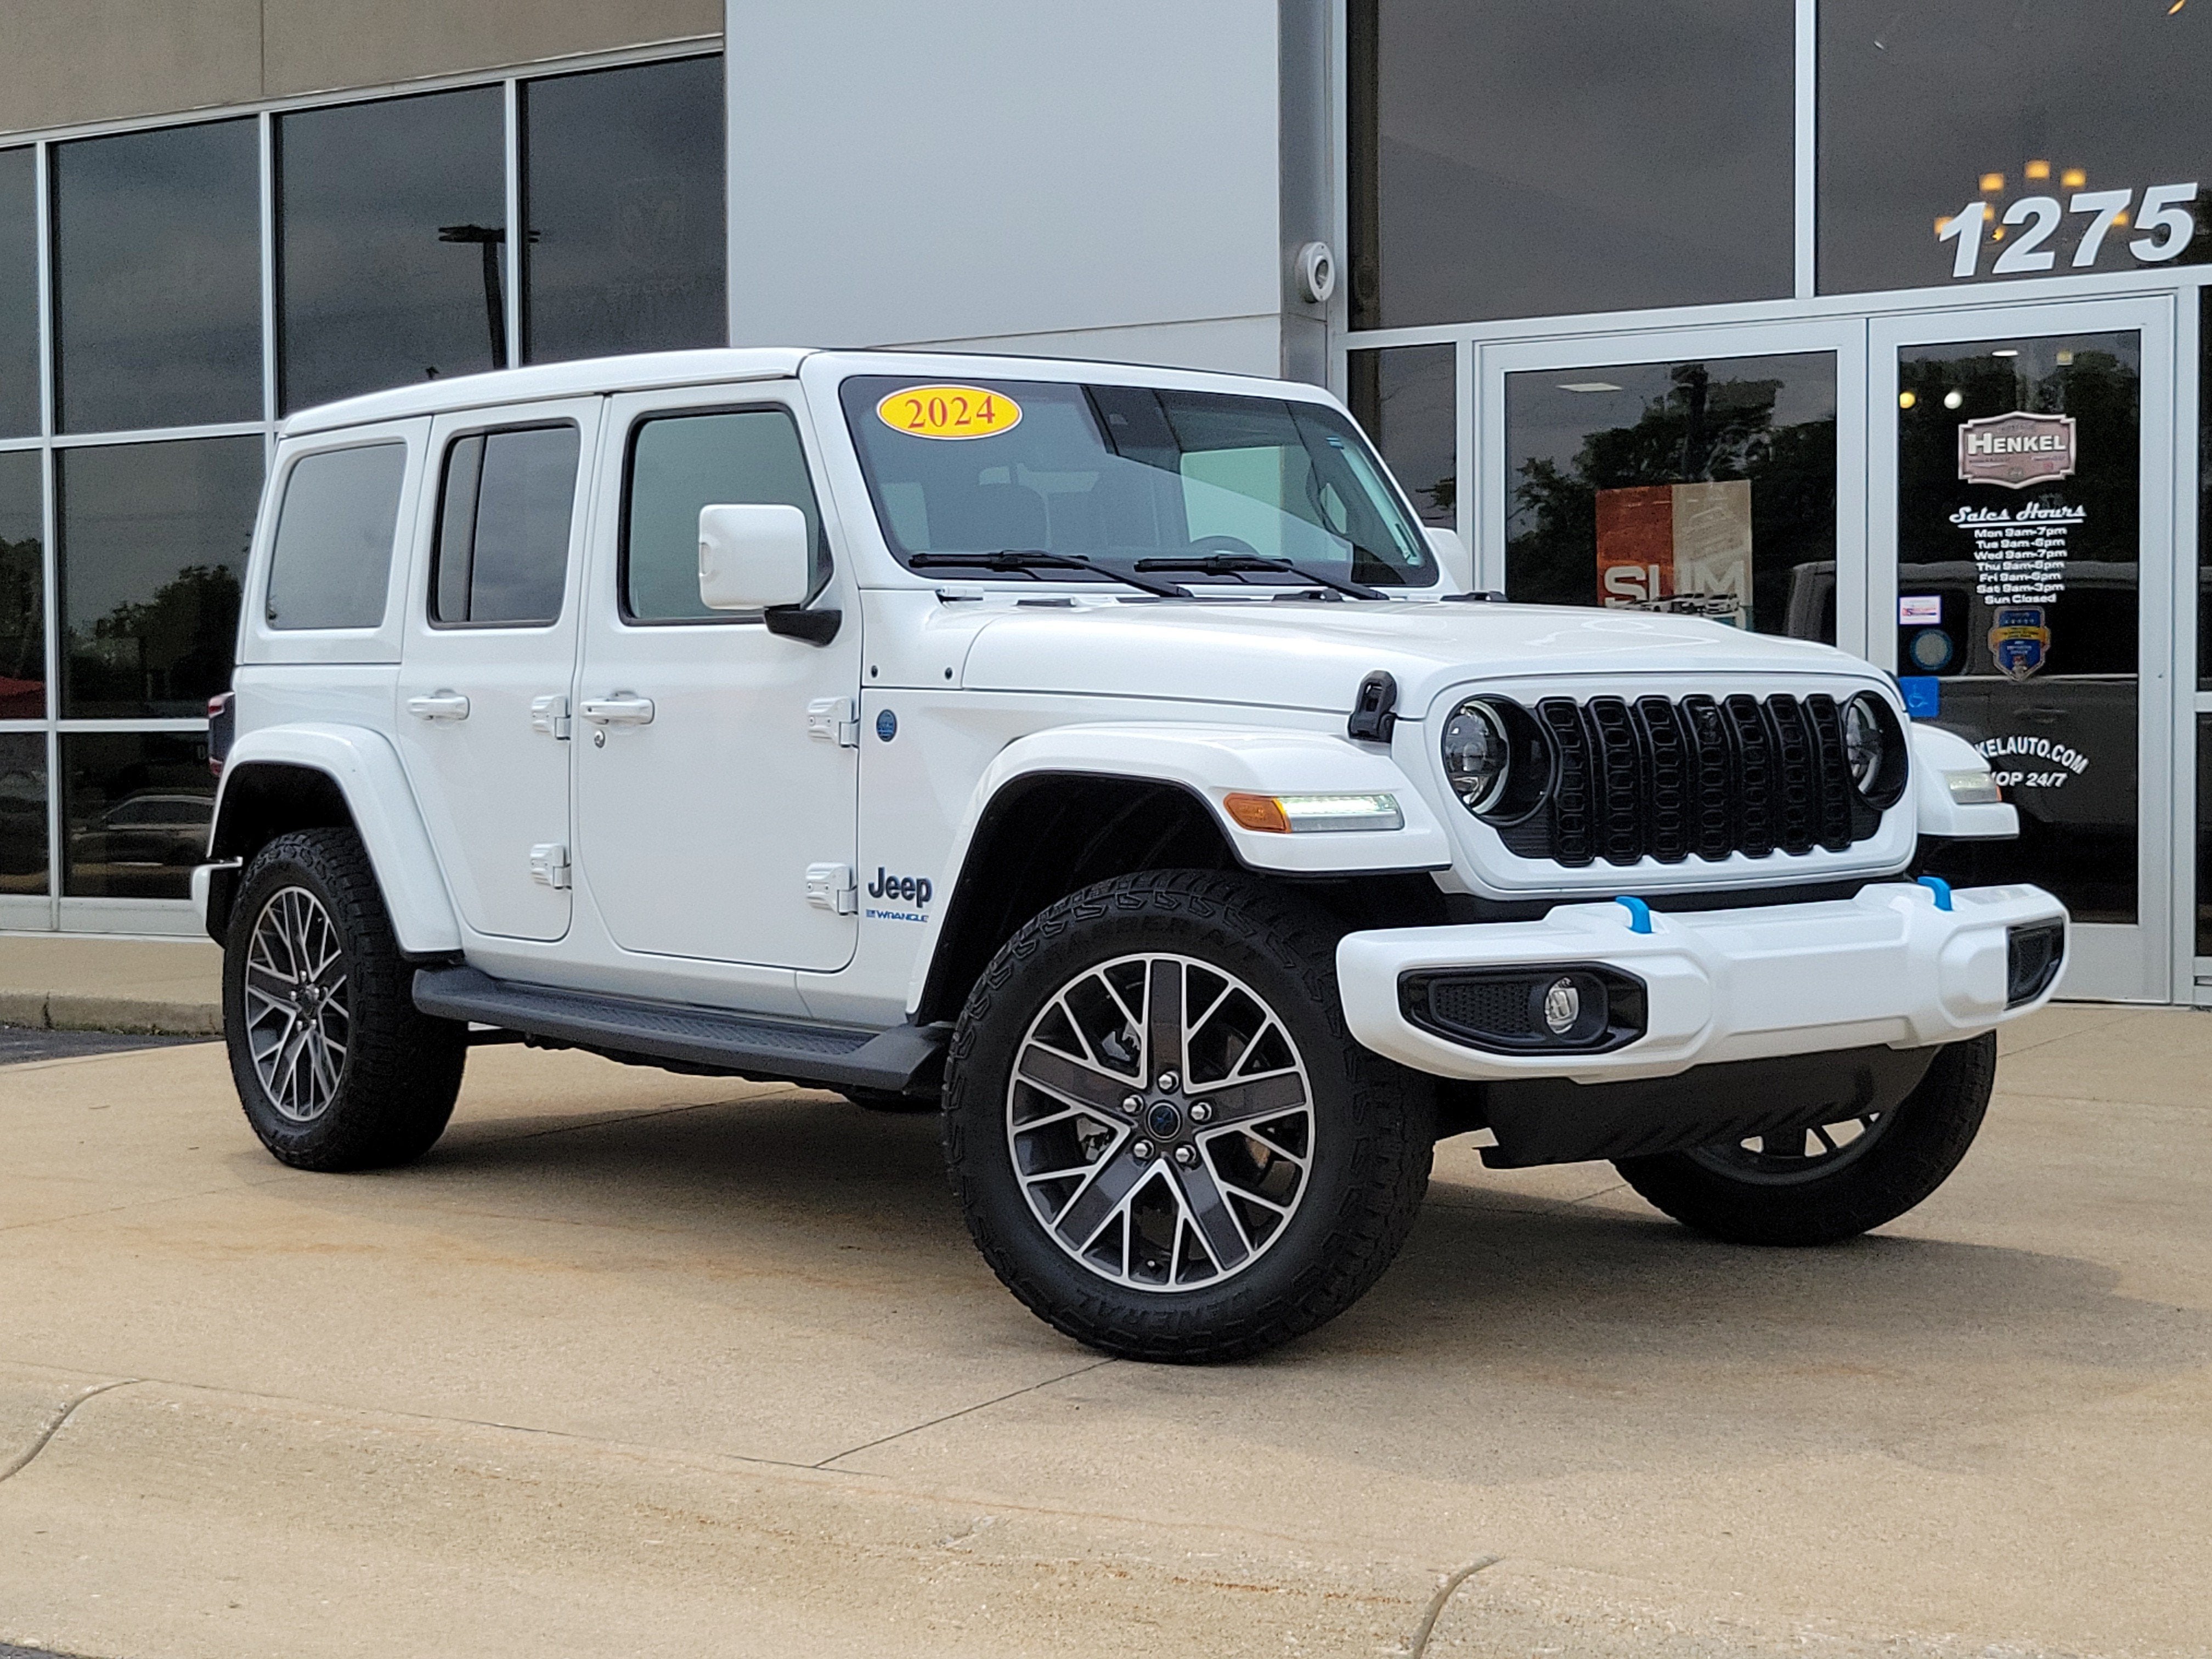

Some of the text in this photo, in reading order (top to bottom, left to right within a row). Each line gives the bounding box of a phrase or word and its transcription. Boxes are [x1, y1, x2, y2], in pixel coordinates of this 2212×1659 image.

[1939, 183, 2198, 278] 1275
[905, 396, 995, 428] 2024
[1967, 433, 2067, 455] HENKEL
[1949, 501, 2087, 522] Sales Hours
[1974, 526, 2068, 538] Mon 9am-7pm
[1976, 540, 1999, 549] Tue
[1973, 549, 2068, 560] Wed 9am-7pm
[1976, 562, 2001, 571] Thu
[1979, 573, 1998, 583] Fri
[1976, 584, 2001, 594] Sat
[1984, 593, 2057, 605] Sun Closed
[2025, 772, 2068, 787] 24/7
[868, 866, 932, 909] Jeep
